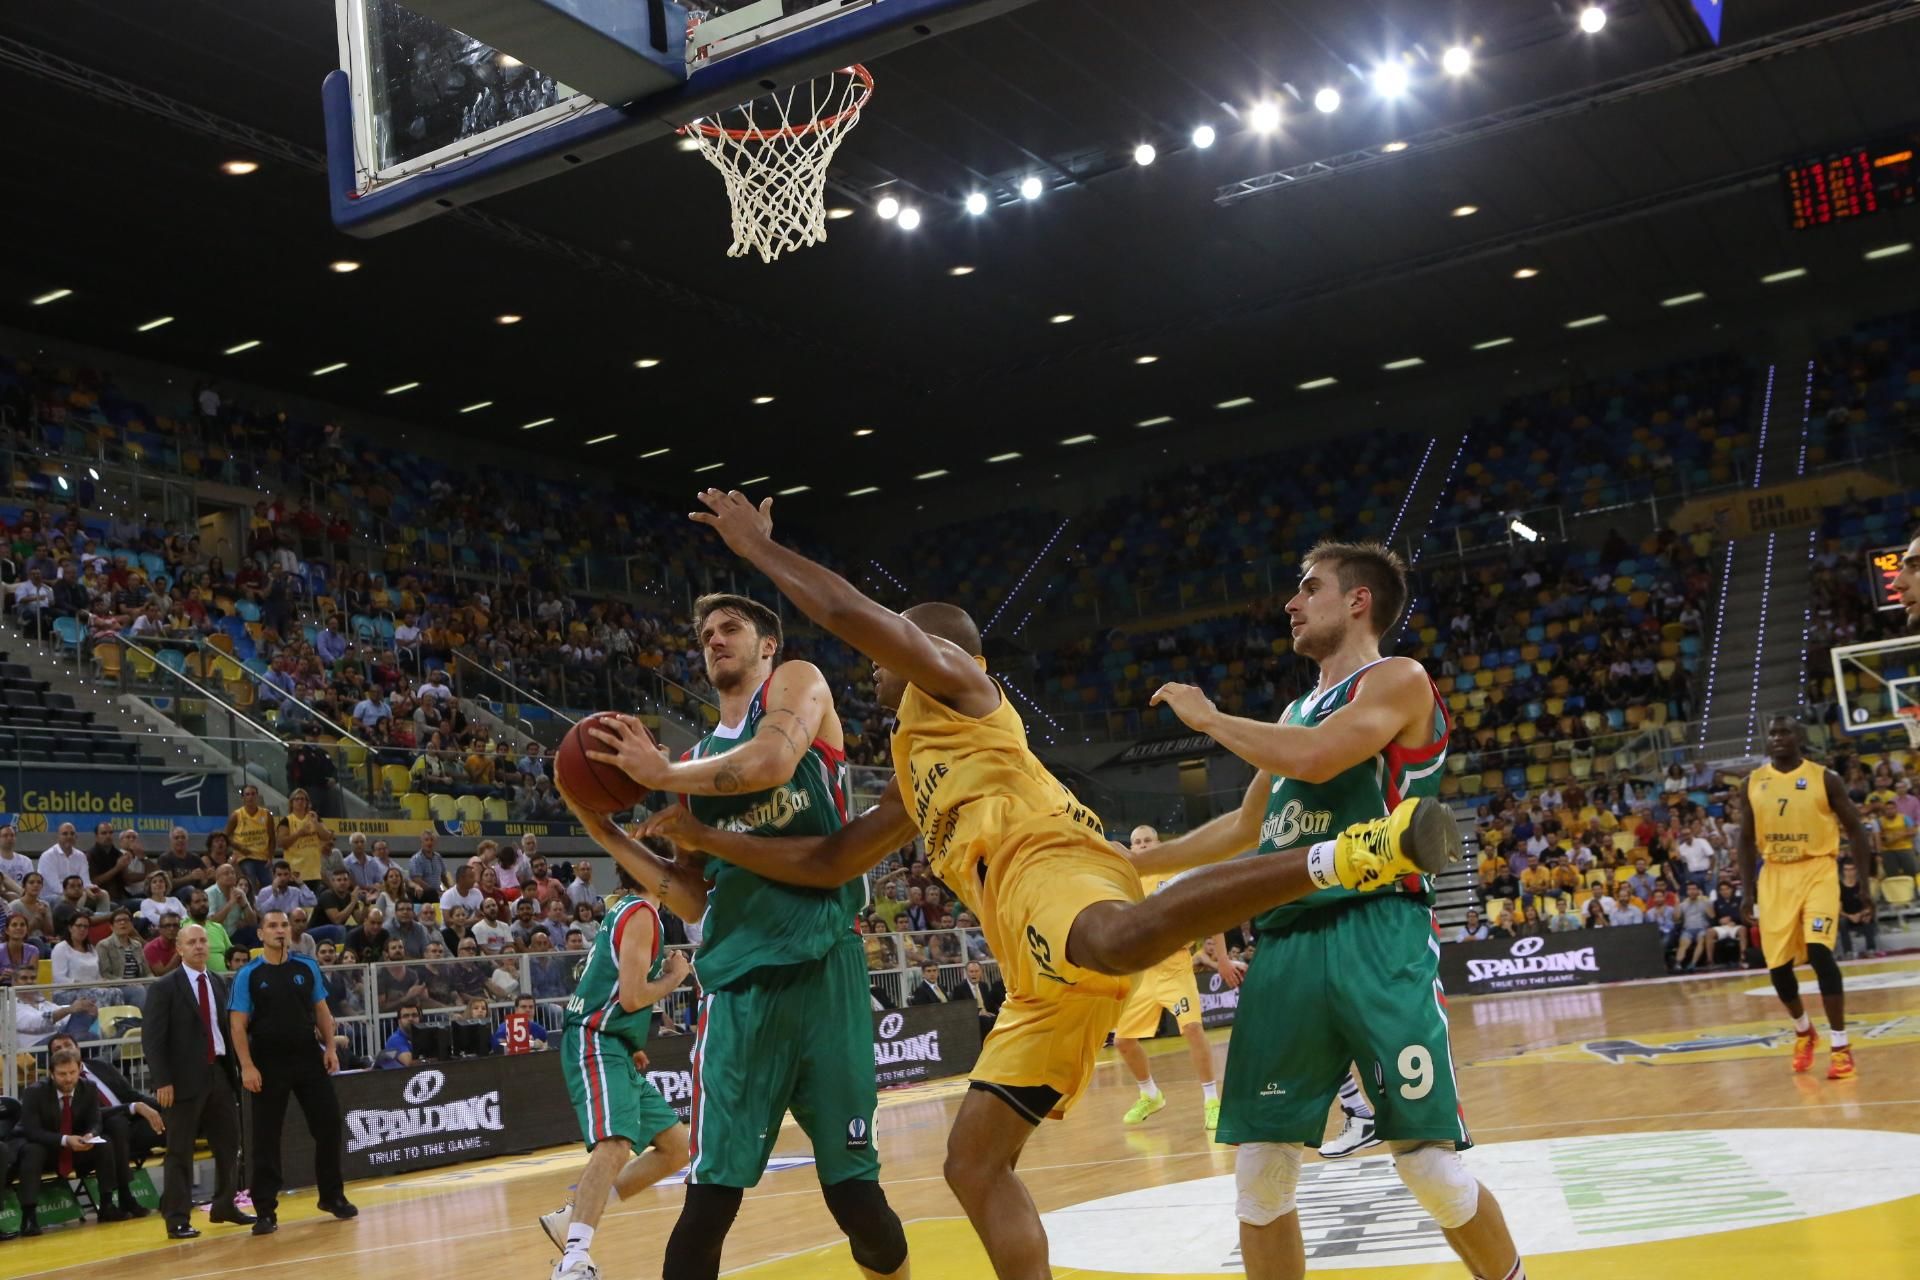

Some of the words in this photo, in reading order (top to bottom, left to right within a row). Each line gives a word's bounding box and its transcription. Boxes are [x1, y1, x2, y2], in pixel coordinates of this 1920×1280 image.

[1874, 554, 1898, 571] 42
[23, 791, 104, 812] Cabildo
[109, 792, 134, 812] de
[1777, 798, 1788, 816] 7
[111, 817, 134, 830] GRAN
[339, 821, 357, 833] GRAN
[360, 822, 389, 833] CANARIA
[505, 824, 522, 835] GRAN
[523, 824, 548, 835] CANARIA
[1824, 917, 1834, 935] 7
[1466, 947, 1600, 982] SPALDING
[1491, 980, 1513, 989] TRUE
[1515, 979, 1528, 987] TO
[1529, 976, 1547, 985] THE
[1548, 974, 1575, 983] GAME
[1180, 997, 1190, 1013] 9
[513, 1017, 527, 1043] 5
[1397, 1044, 1435, 1101] 9
[345, 1090, 505, 1153] SPALDING
[368, 1151, 401, 1165] TRUE
[404, 1147, 420, 1160] TO
[422, 1142, 446, 1157] THE
[448, 1136, 483, 1152] GAME
